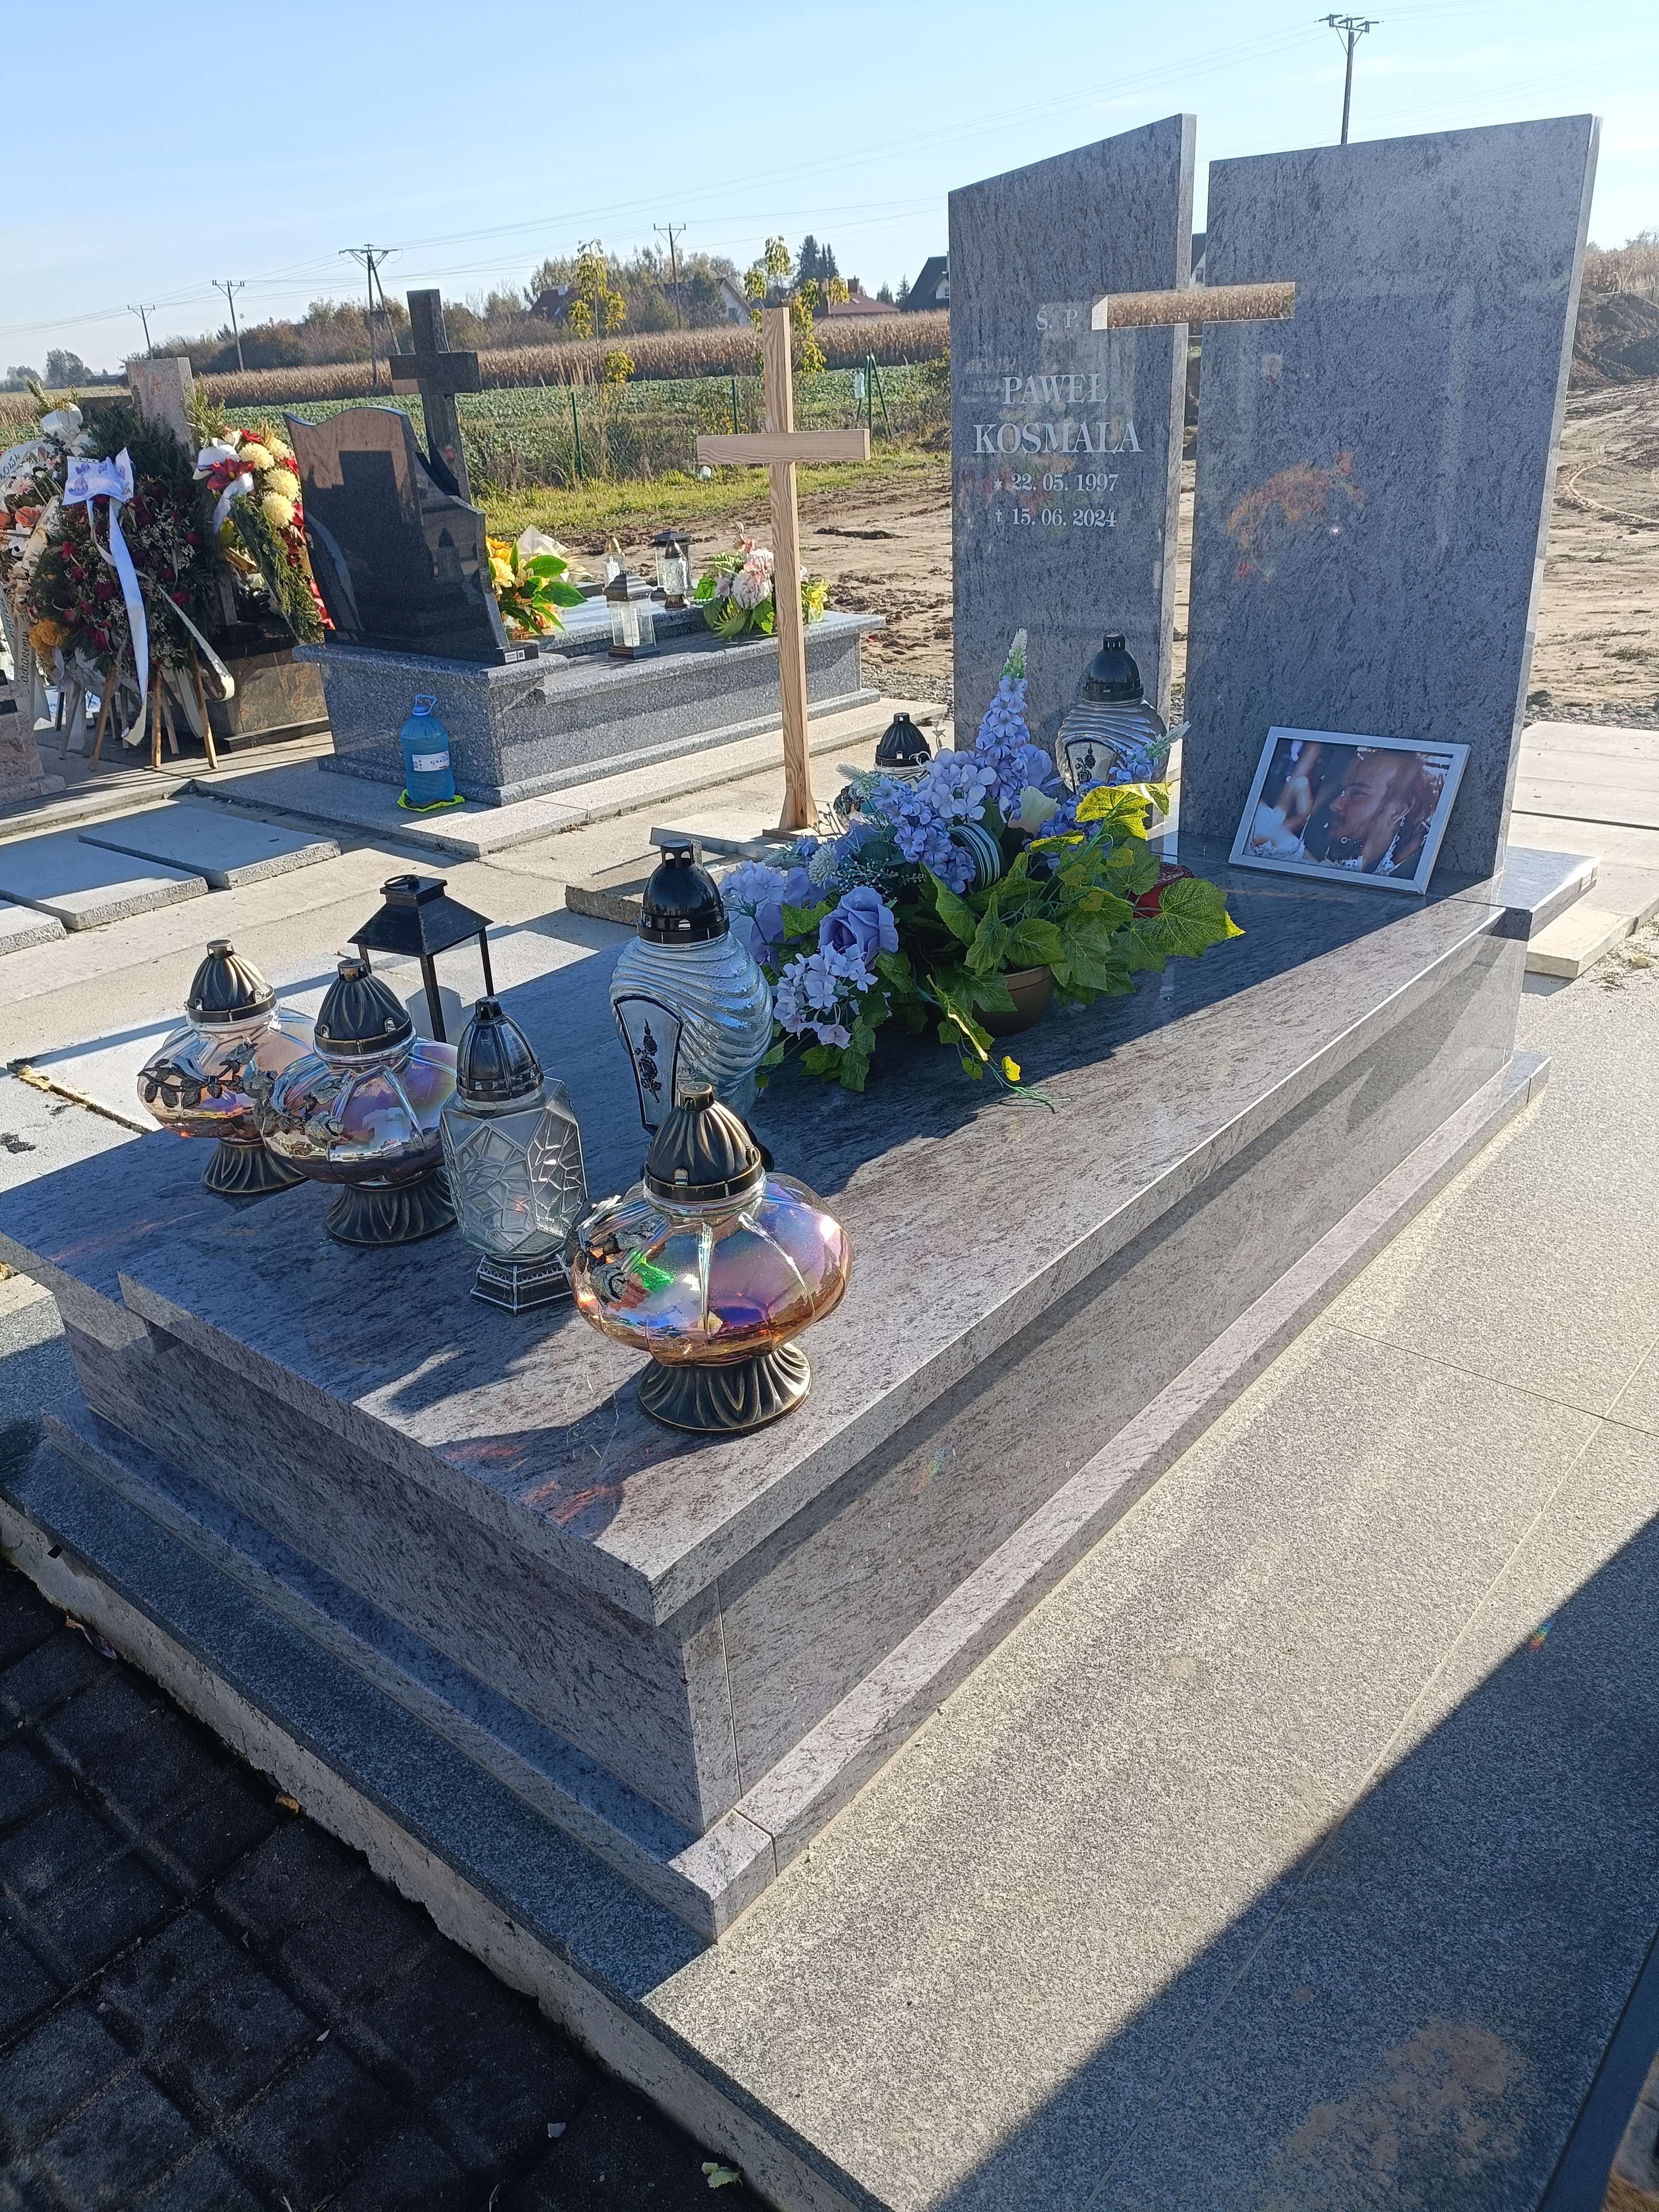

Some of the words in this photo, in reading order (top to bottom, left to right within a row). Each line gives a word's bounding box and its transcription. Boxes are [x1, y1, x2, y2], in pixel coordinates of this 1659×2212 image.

[1036, 305, 1052, 330] Ś.
[1064, 309, 1079, 328] P.
[1002, 373, 1109, 404] PAWEŁ
[973, 420, 1144, 454] KOSMALA
[1011, 473, 1037, 491] 22.
[1042, 473, 1068, 491] 05.
[1076, 473, 1119, 491] 1997
[1011, 508, 1035, 525] 15.
[1041, 508, 1067, 526] 06.
[1073, 508, 1117, 527] 2024
[18, 631, 30, 694] ochanemu
